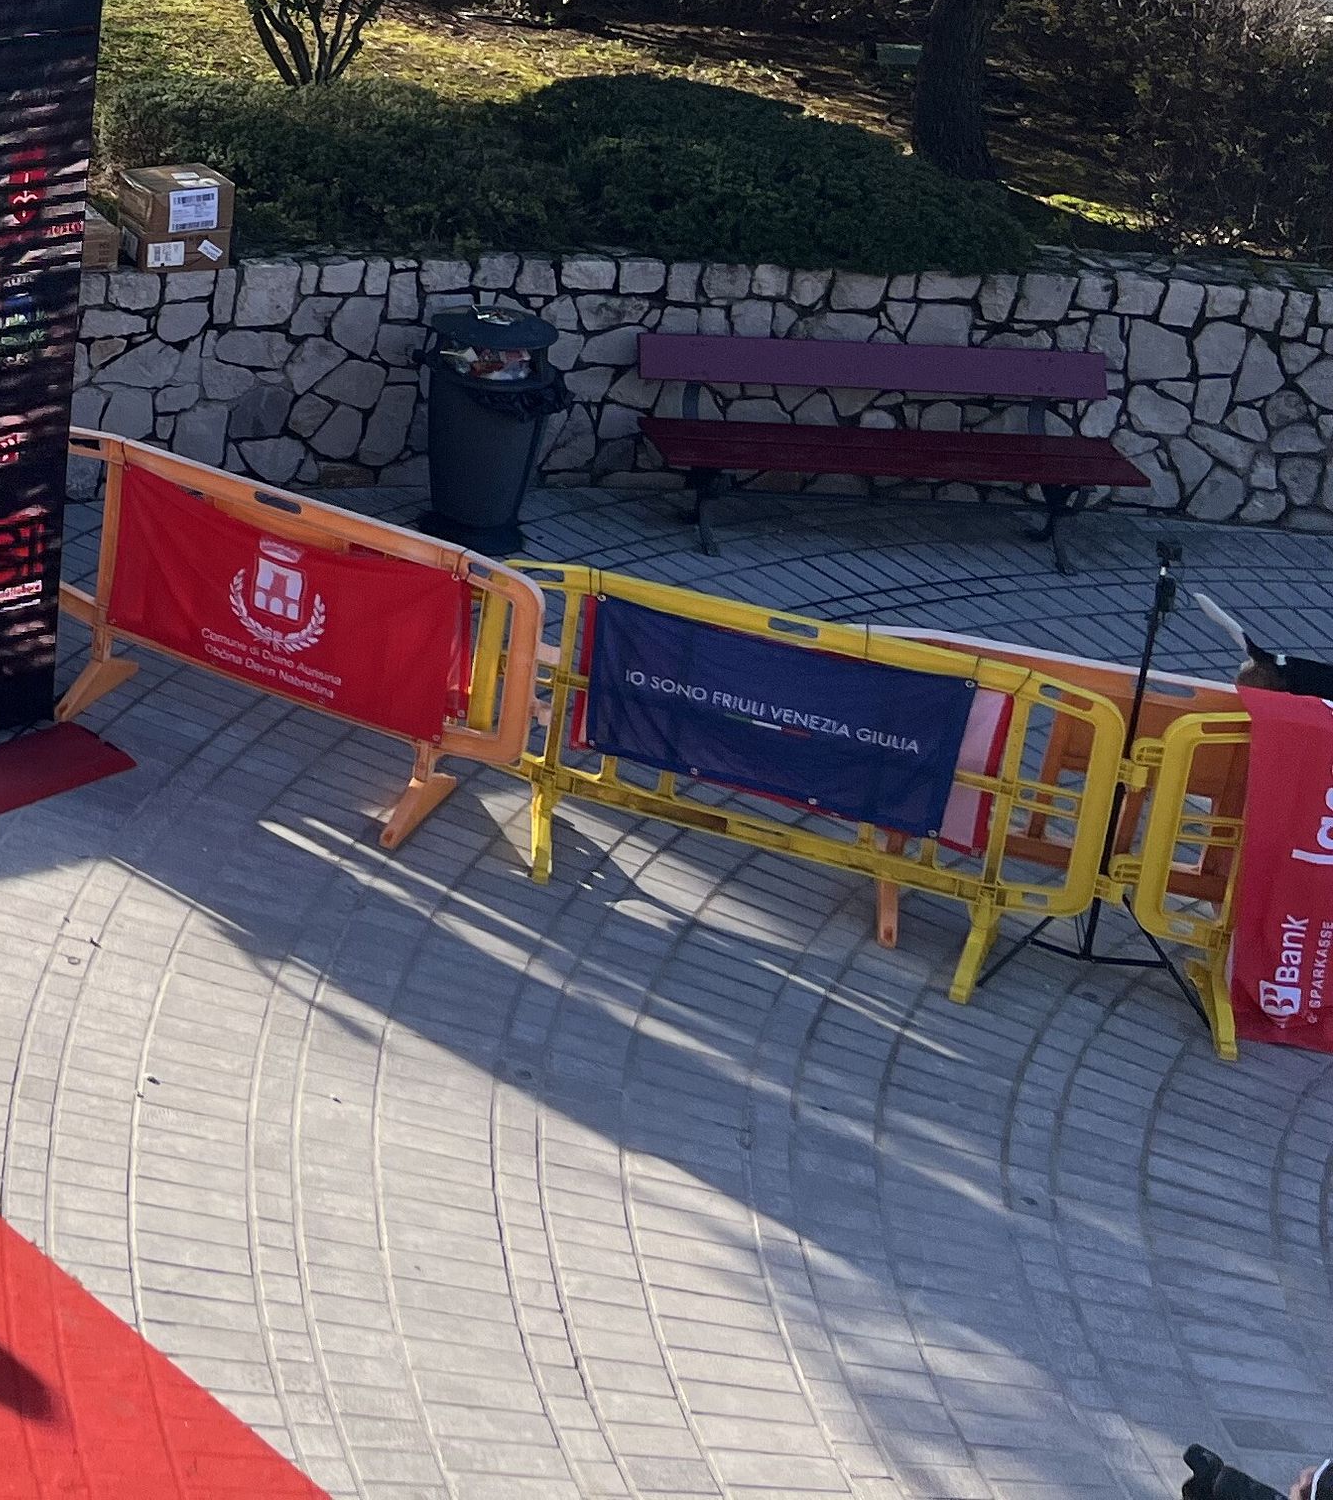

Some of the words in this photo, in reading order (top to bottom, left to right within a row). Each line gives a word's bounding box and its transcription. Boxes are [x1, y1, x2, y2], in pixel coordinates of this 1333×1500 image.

[201, 627, 247, 652] Comune
[249, 645, 260, 656] di
[262, 649, 294, 669] Duino
[296, 662, 342, 687] Aurisina
[245, 657, 276, 677] Devin
[624, 668, 646, 686] IO
[650, 674, 707, 701] SONO
[712, 690, 765, 717] FRIULI
[769, 705, 851, 739] VENEZIA
[855, 727, 919, 754] GIULIA
[1274, 913, 1309, 983] Bank
